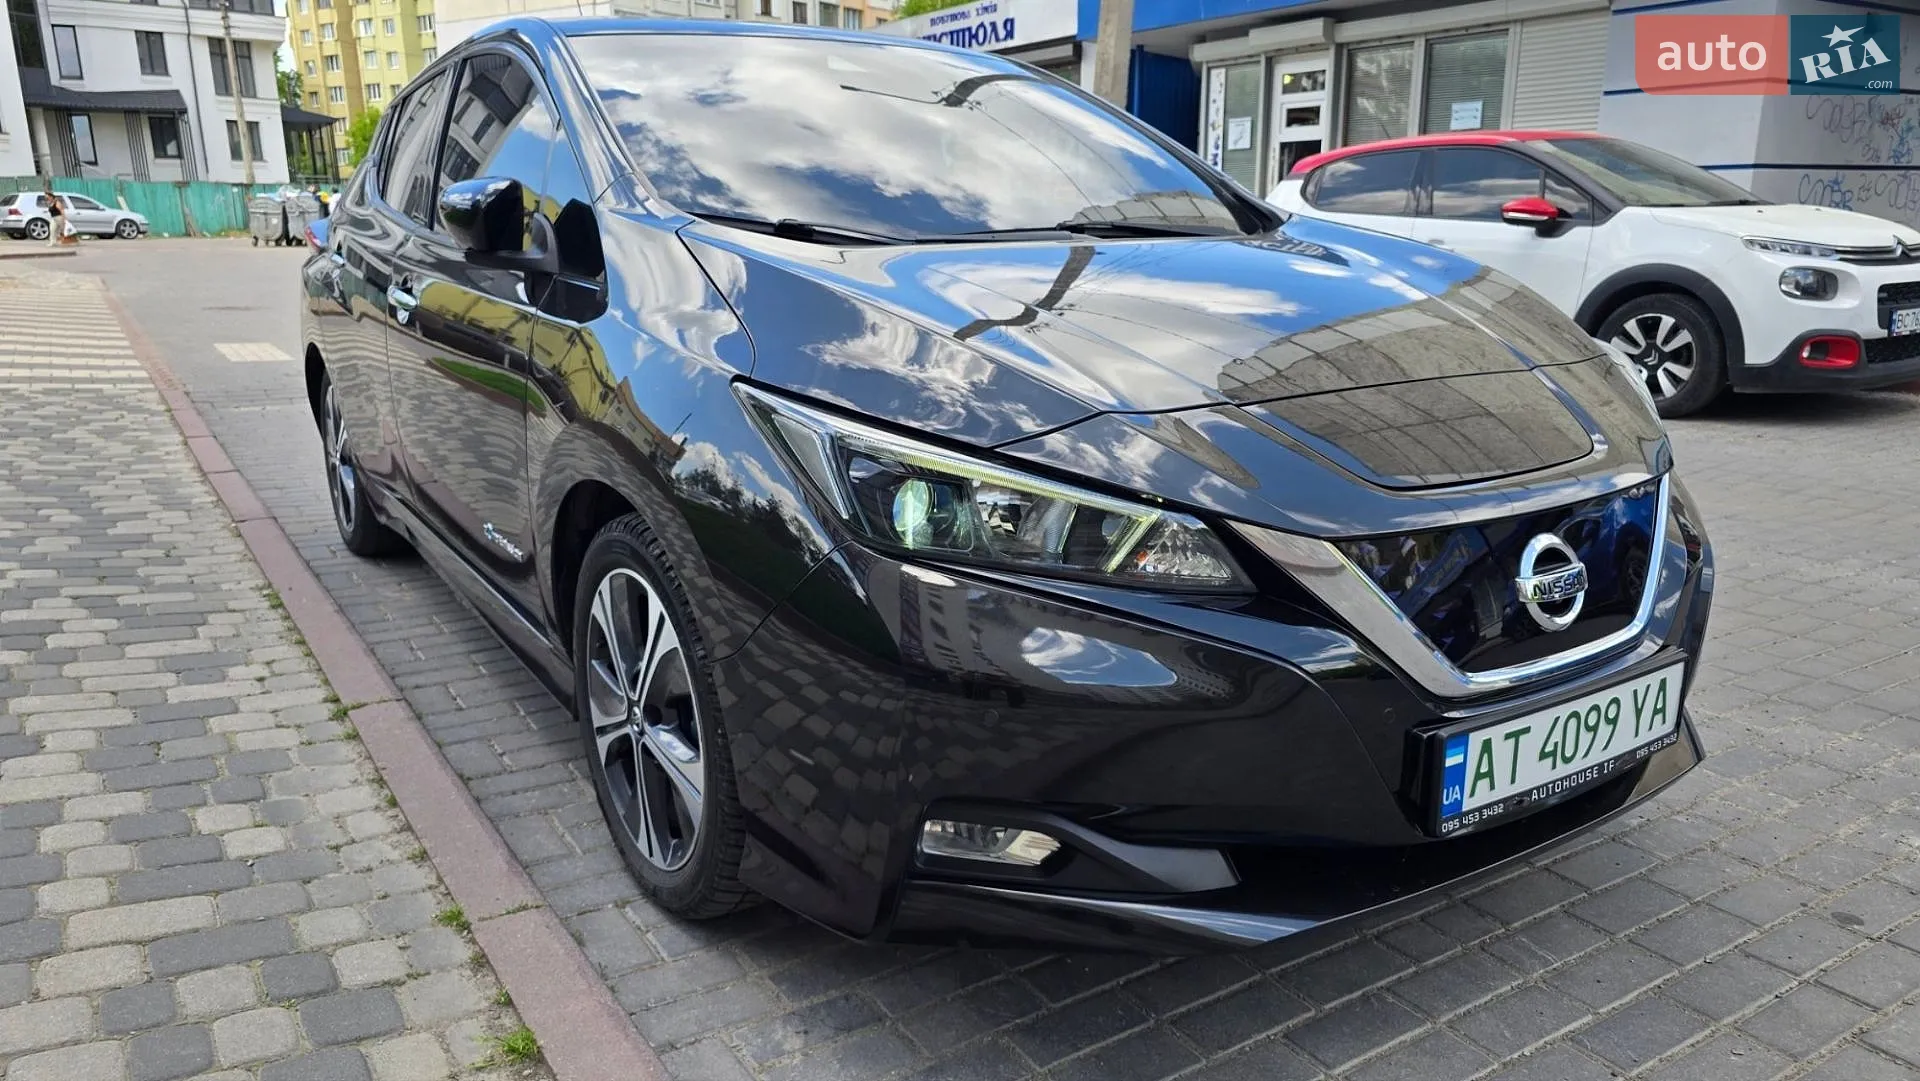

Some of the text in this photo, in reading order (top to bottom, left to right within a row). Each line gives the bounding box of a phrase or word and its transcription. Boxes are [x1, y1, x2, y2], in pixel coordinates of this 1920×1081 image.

[1469, 677, 1667, 798] AT 4099 YA
[1636, 746, 1649, 759] 095
[1649, 740, 1662, 752] 453
[1443, 785, 1461, 805] UA
[1531, 760, 1615, 802] AUTOHOUSE IF
[1441, 803, 1505, 833] 095 453 3432
